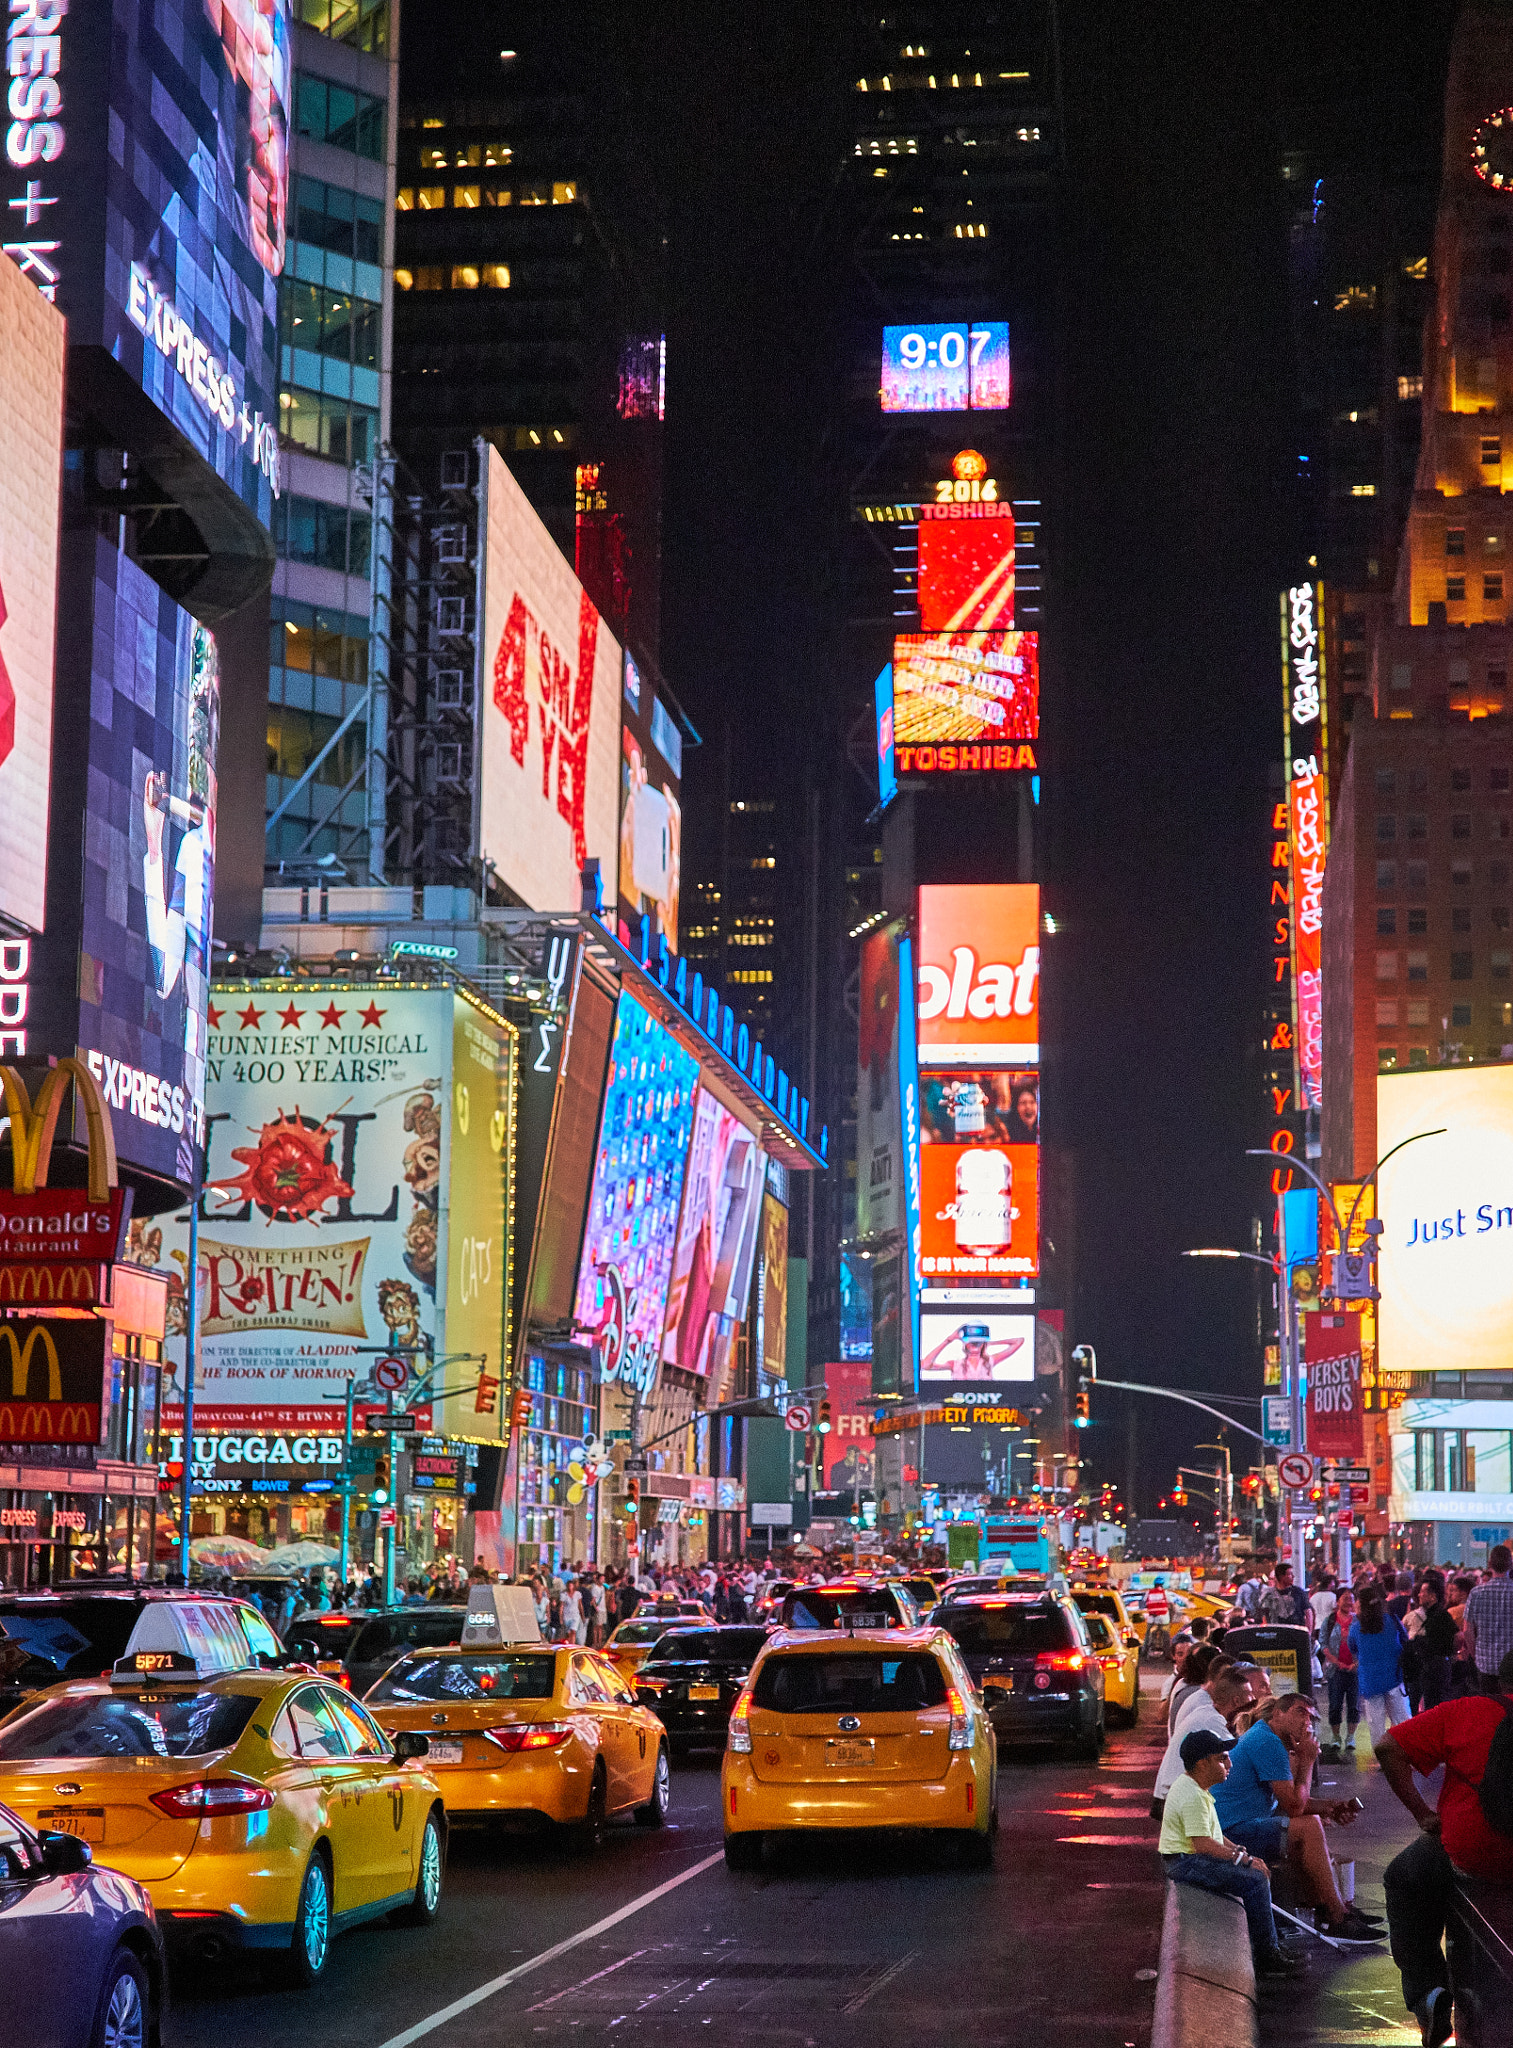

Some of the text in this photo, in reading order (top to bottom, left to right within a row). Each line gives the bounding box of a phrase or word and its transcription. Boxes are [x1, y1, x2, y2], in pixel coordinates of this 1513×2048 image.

[125, 259, 237, 433] EXPRESS
[900, 330, 991, 369] 9:07
[936, 479, 998, 503] 2016
[921, 502, 1012, 519] TOSHIBA
[894, 745, 1037, 772] TOSHIBA
[1270, 802, 1289, 982] ERNST
[206, 1033, 428, 1055] FUNNIEST MUSICAL
[207, 1060, 225, 1083] N
[232, 1060, 285, 1084] 400
[87, 1048, 185, 1134] EXPRESS
[1406, 1208, 1467, 1247] Just
[220, 1246, 345, 1265] SOMETHING
[460, 1236, 493, 1307] CATS
[200, 1249, 363, 1324] ROTTEN!
[219, 1358, 239, 1367] AND
[296, 1345, 359, 1356] ALADDIN
[202, 1367, 357, 1379] HE BOOK OF MORMON
[1307, 1355, 1362, 1389] JERSEY
[1314, 1383, 1354, 1413] BOYS
[1, 1508, 37, 1526] EXPRESS
[53, 1510, 86, 1528] EXPRESS
[468, 1613, 496, 1626] 6G46
[135, 1654, 174, 1669] 5P71
